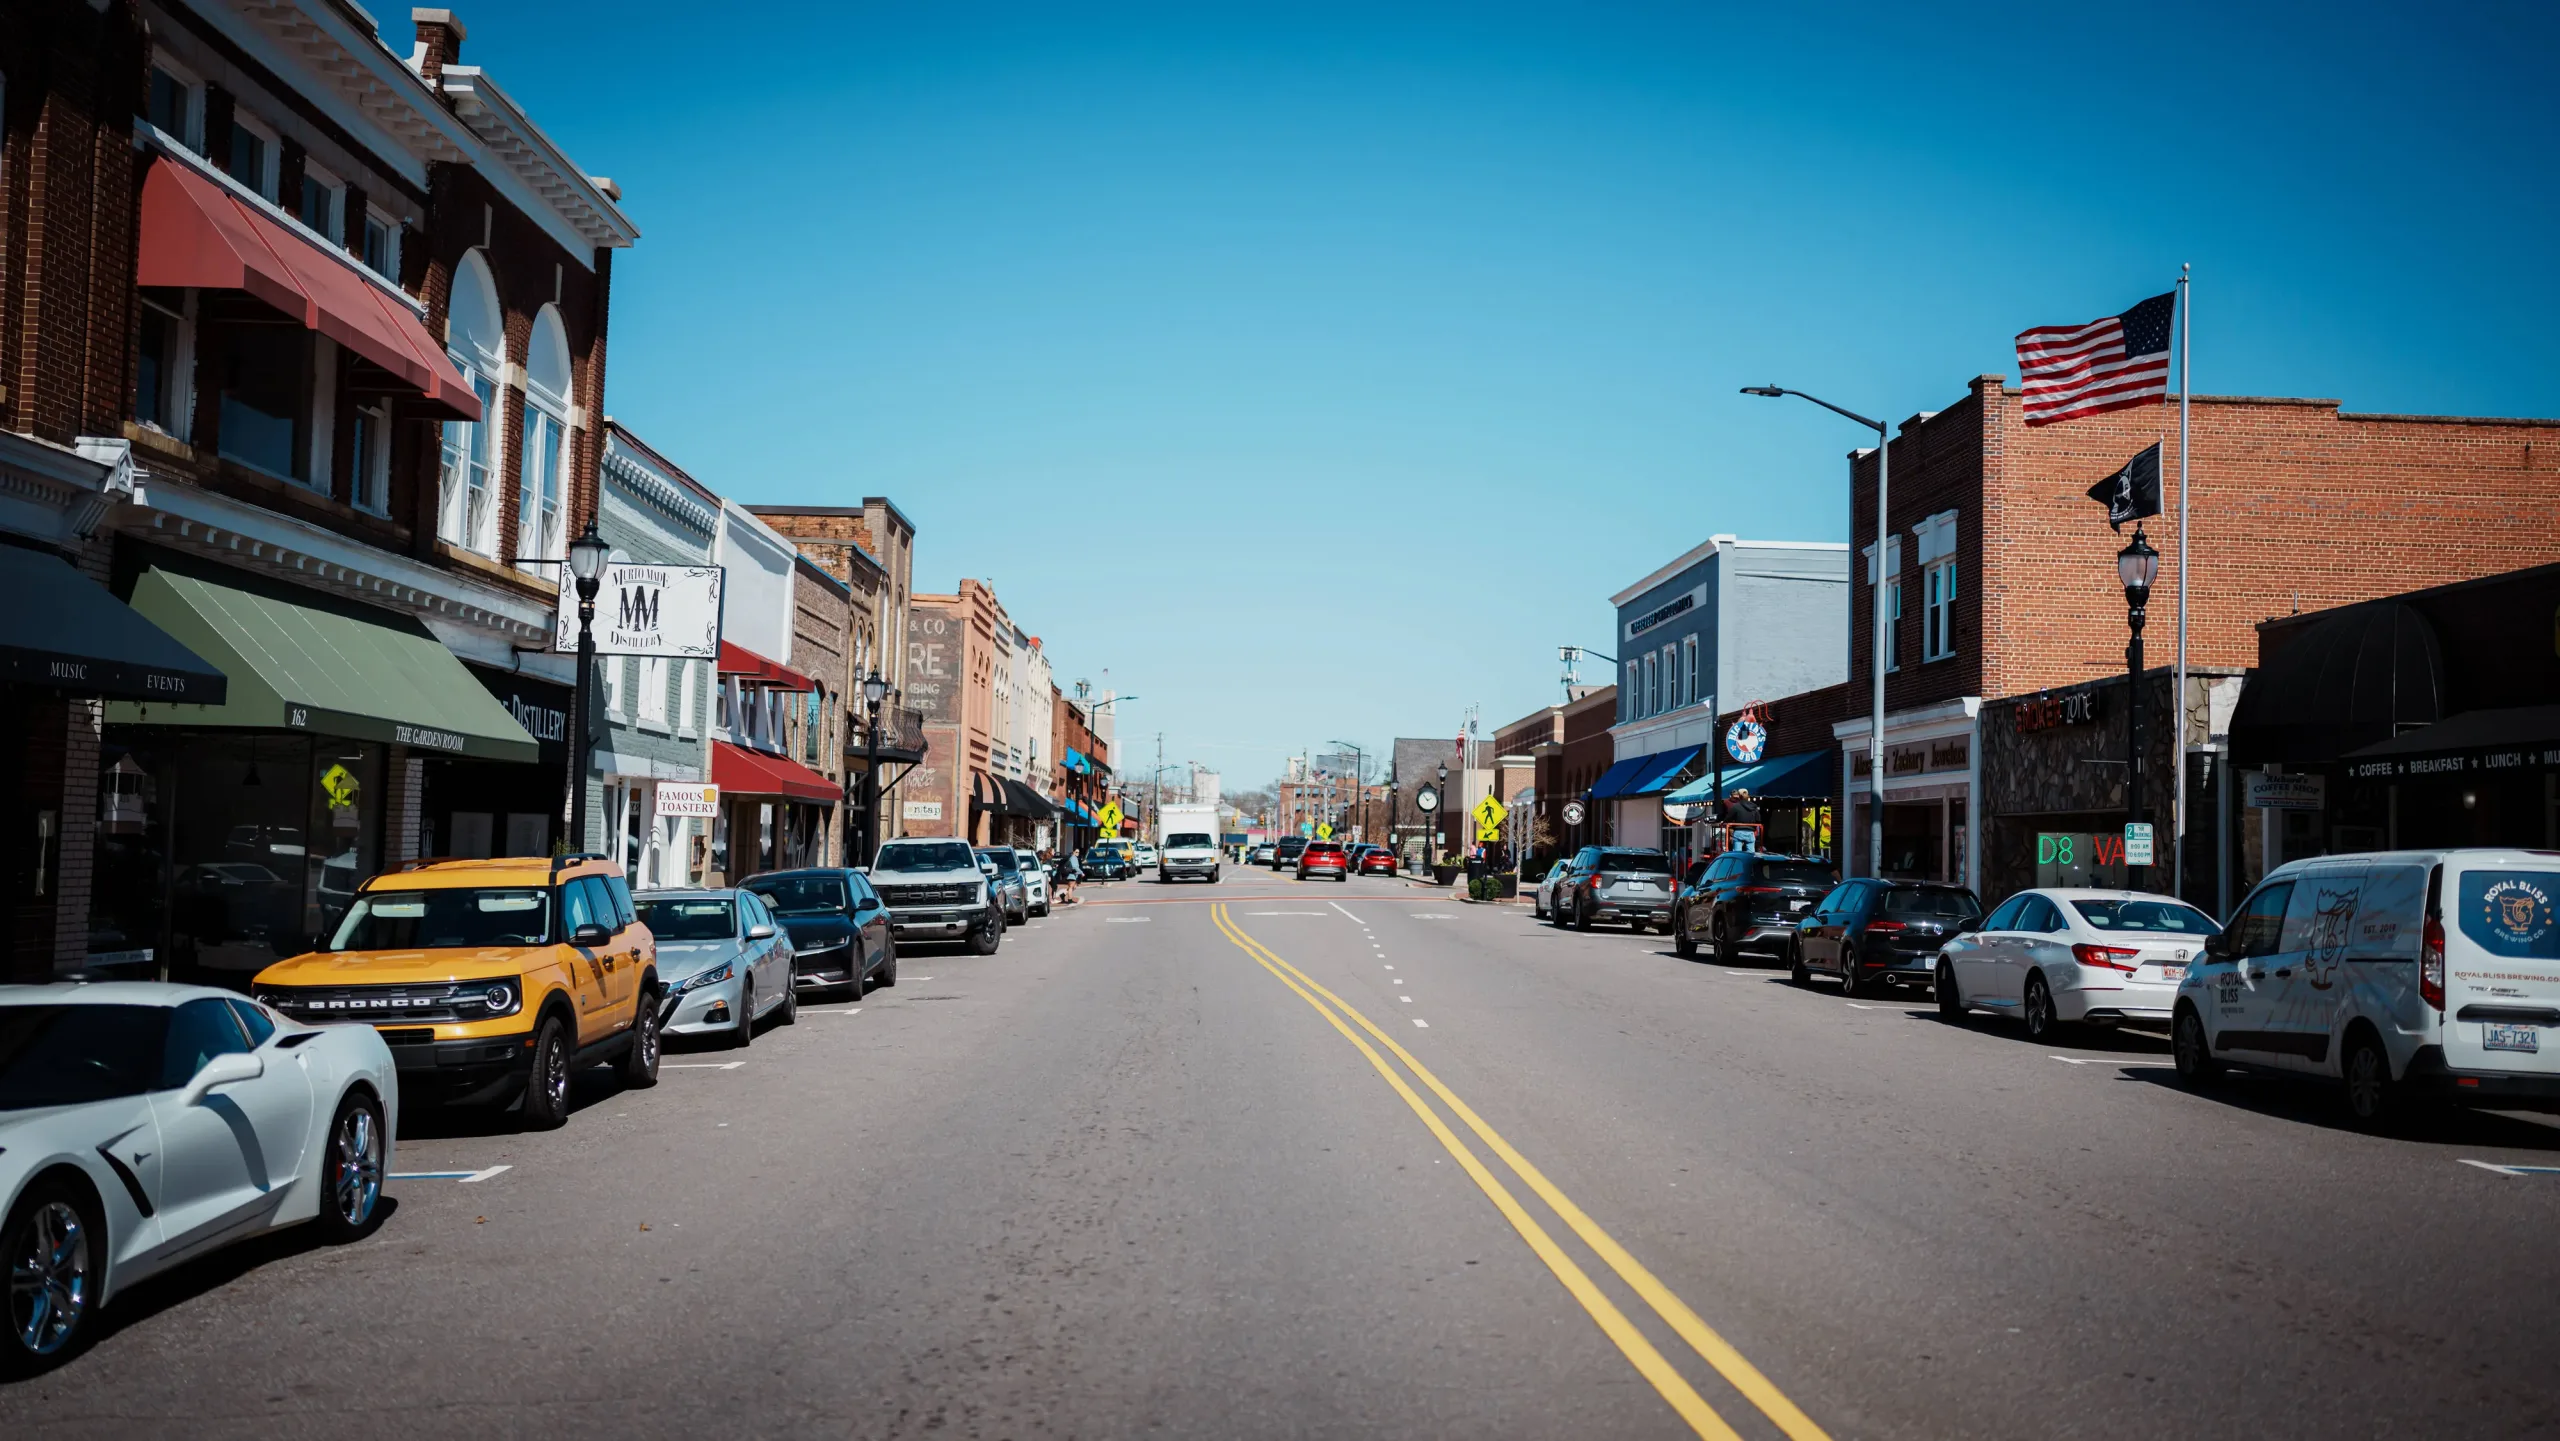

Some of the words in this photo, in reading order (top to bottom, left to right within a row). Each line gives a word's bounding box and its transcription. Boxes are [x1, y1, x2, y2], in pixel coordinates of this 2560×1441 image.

[612, 568, 644, 587] MURTO
[647, 568, 670, 588] MADE
[909, 620, 919, 632] &
[923, 618, 948, 635] CO.
[610, 631, 664, 648] DISTILLERY
[50, 661, 87, 680] MUSIC
[147, 674, 185, 692] EVENTS
[291, 708, 306, 726] 162
[512, 694, 566, 742] DISTILLERY
[395, 725, 412, 742] THE
[413, 729, 443, 747] GARDEN
[442, 733, 464, 751] ROOM
[1728, 724, 1741, 740] BIG
[1737, 751, 1757, 762] BBQ
[1893, 747, 1925, 773] Zachary
[2359, 762, 2393, 777] COFFEE
[2410, 757, 2465, 774] BREAKFAST
[2485, 752, 2521, 769] LUNCH
[658, 791, 703, 801] FAMOUS
[2253, 783, 2290, 793] COFFEE
[2293, 784, 2320, 795] SHOP
[661, 802, 715, 813] TOASTERY
[2127, 826, 2133, 837] 2
[2038, 835, 2074, 865] D8
[890, 890, 959, 900] FORD
[2483, 880, 2516, 903] ROYAL
[2518, 880, 2548, 904] BLISS
[2494, 928, 2533, 943] BREWING
[2220, 972, 2243, 986] ROYAL
[2455, 971, 2560, 982] ROYALBLISSBREWING.CO
[309, 998, 431, 1009] BRONCO
[2220, 988, 2238, 1003] BLISS
